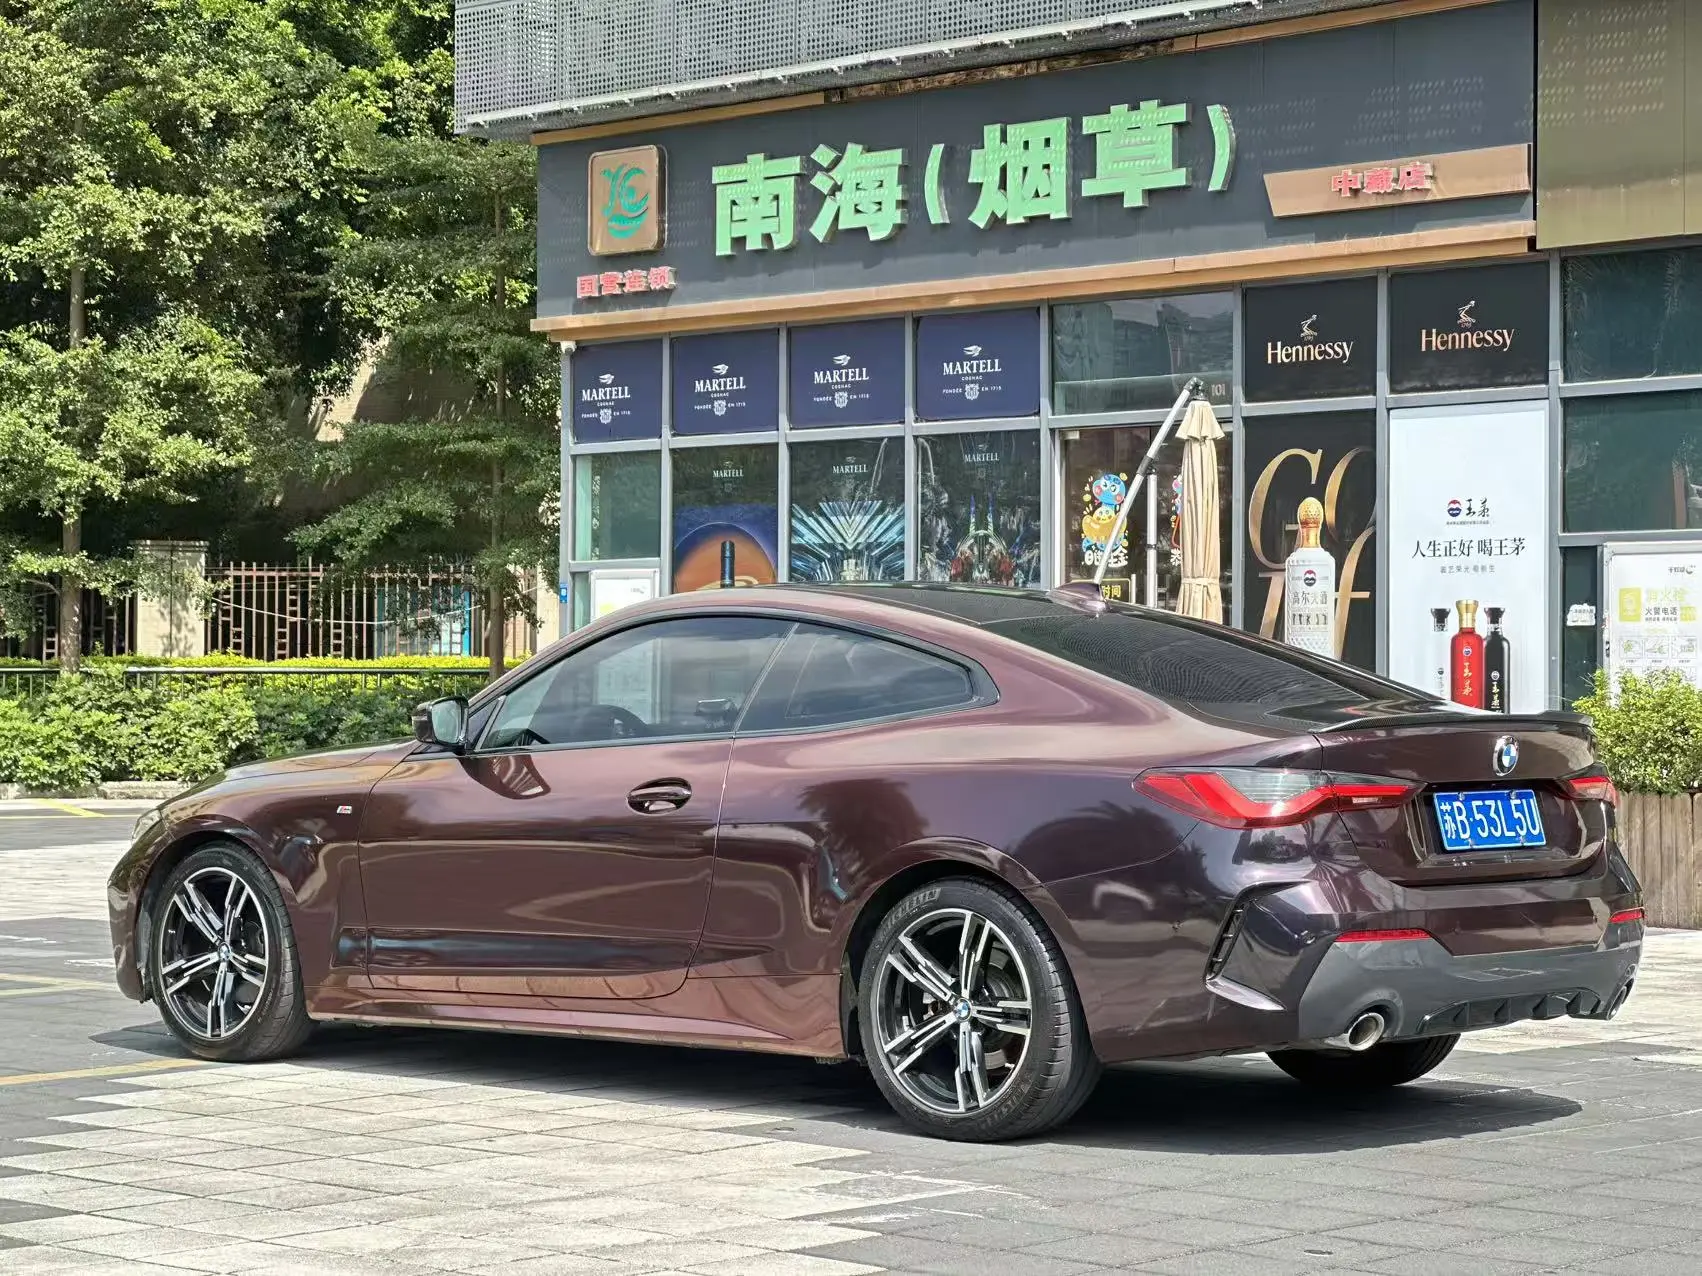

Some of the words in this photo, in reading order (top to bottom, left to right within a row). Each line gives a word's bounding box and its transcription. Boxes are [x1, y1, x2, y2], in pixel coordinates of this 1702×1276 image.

[1420, 328, 1515, 352] Hennessy
[1267, 341, 1354, 364] Hennessy
[814, 367, 870, 384] MARTELL
[943, 358, 1002, 376] MARTELL
[694, 376, 746, 393] MARTELL
[582, 386, 631, 402] MARTELL
[964, 451, 1000, 463] MARTELL
[712, 468, 744, 479] MARTELL
[832, 463, 869, 475] MARTELL
[1412, 538, 1473, 559] 人生正好
[1477, 537, 1526, 556] 喝王茅
[1645, 606, 1679, 616] 火警电话
